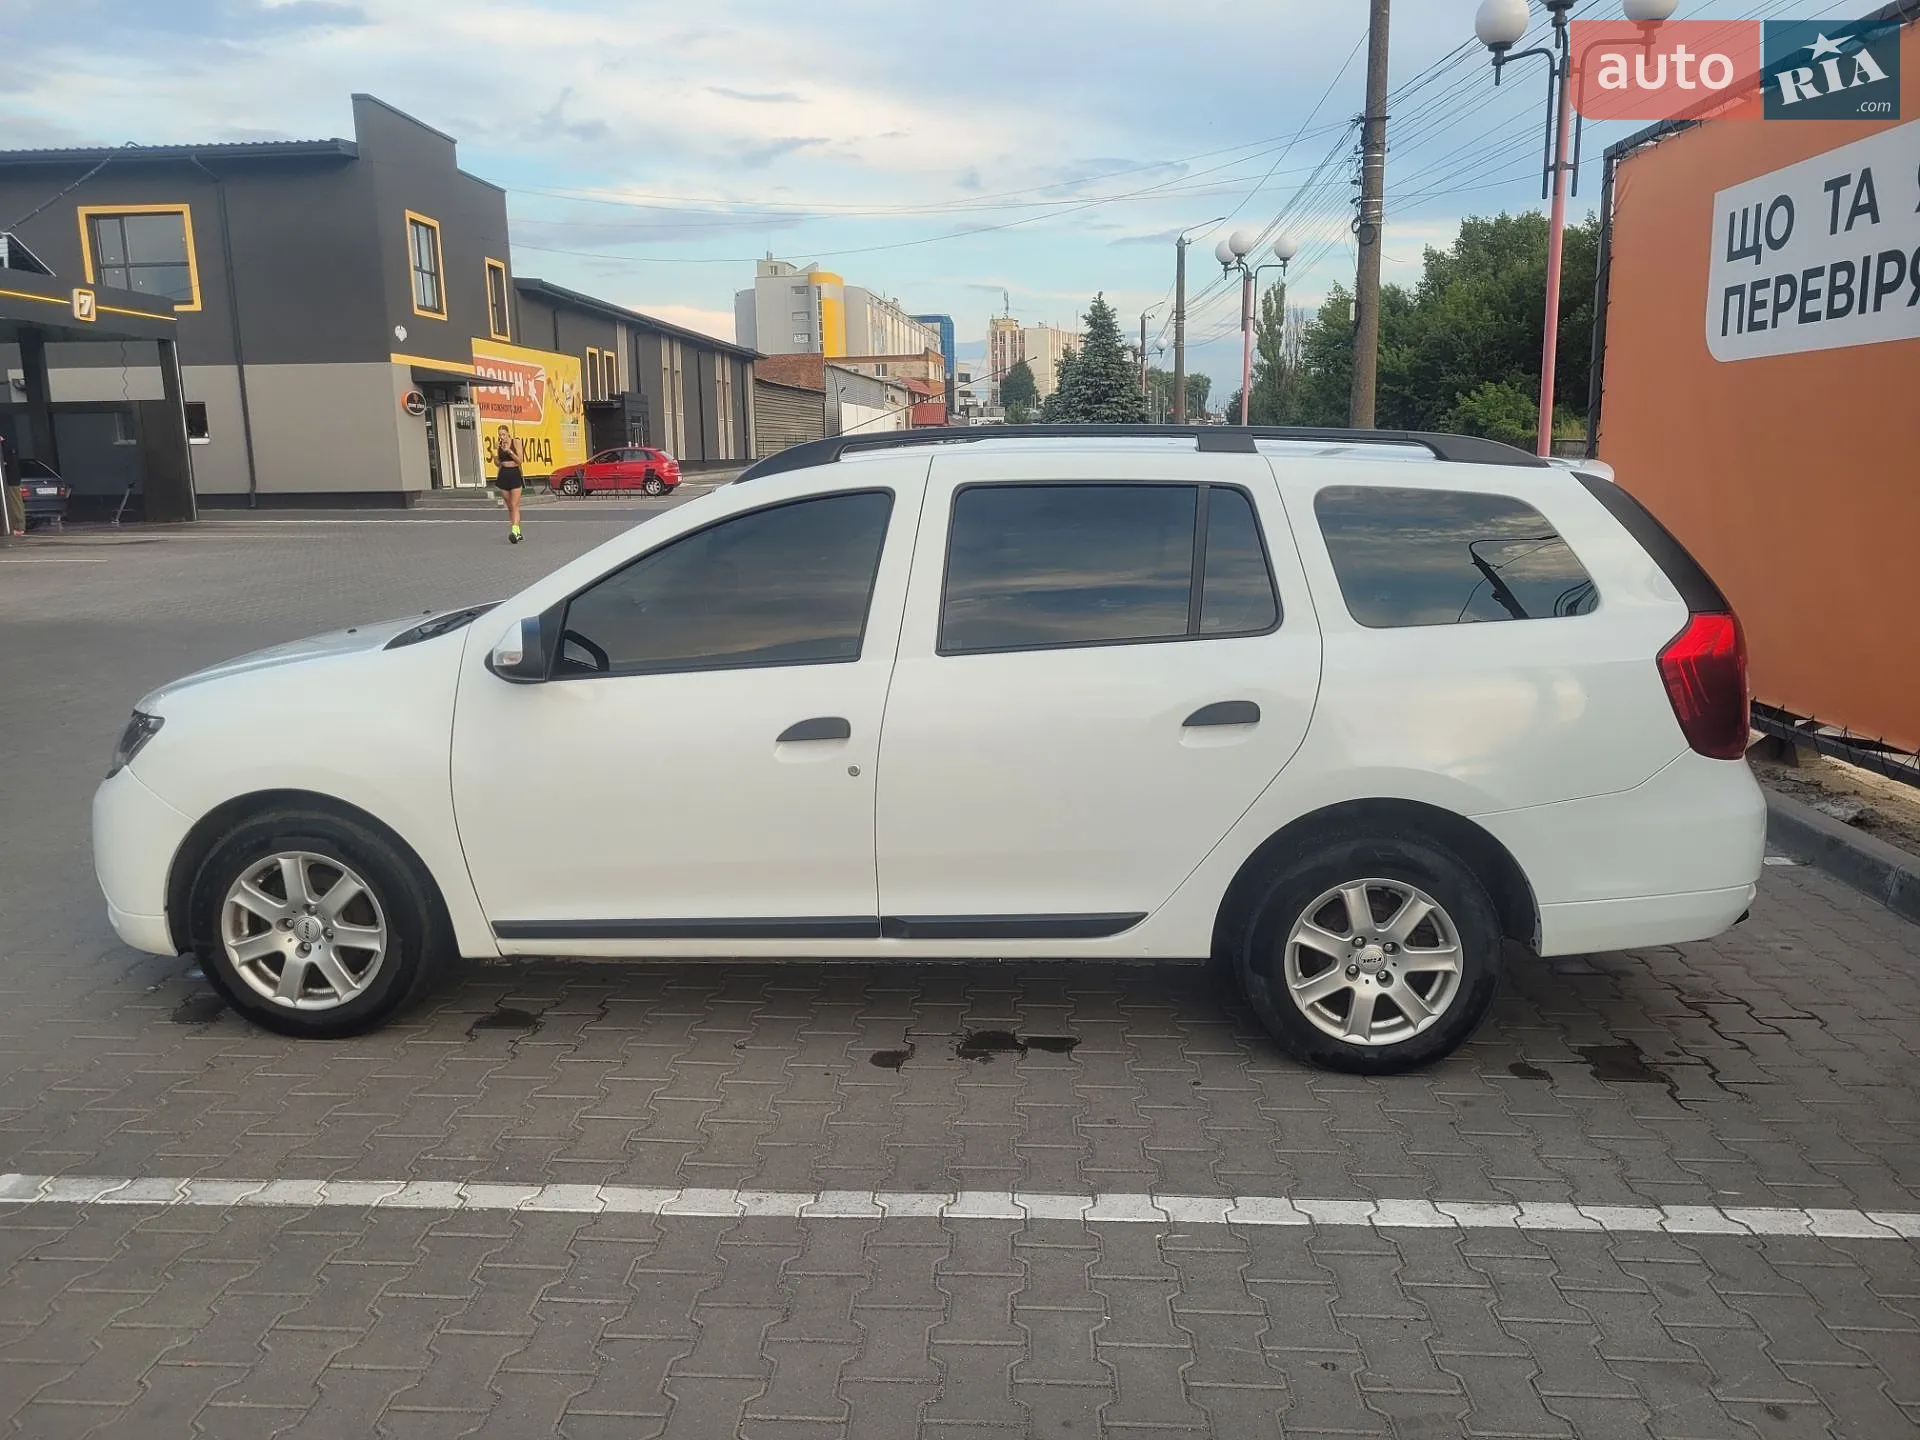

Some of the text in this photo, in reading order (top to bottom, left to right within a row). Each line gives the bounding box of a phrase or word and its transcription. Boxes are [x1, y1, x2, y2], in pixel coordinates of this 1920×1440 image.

[1726, 194, 1795, 266] ЩО
[1823, 166, 1881, 236] ТА
[79, 294, 92, 315] 7
[515, 437, 553, 467] КЛАД
